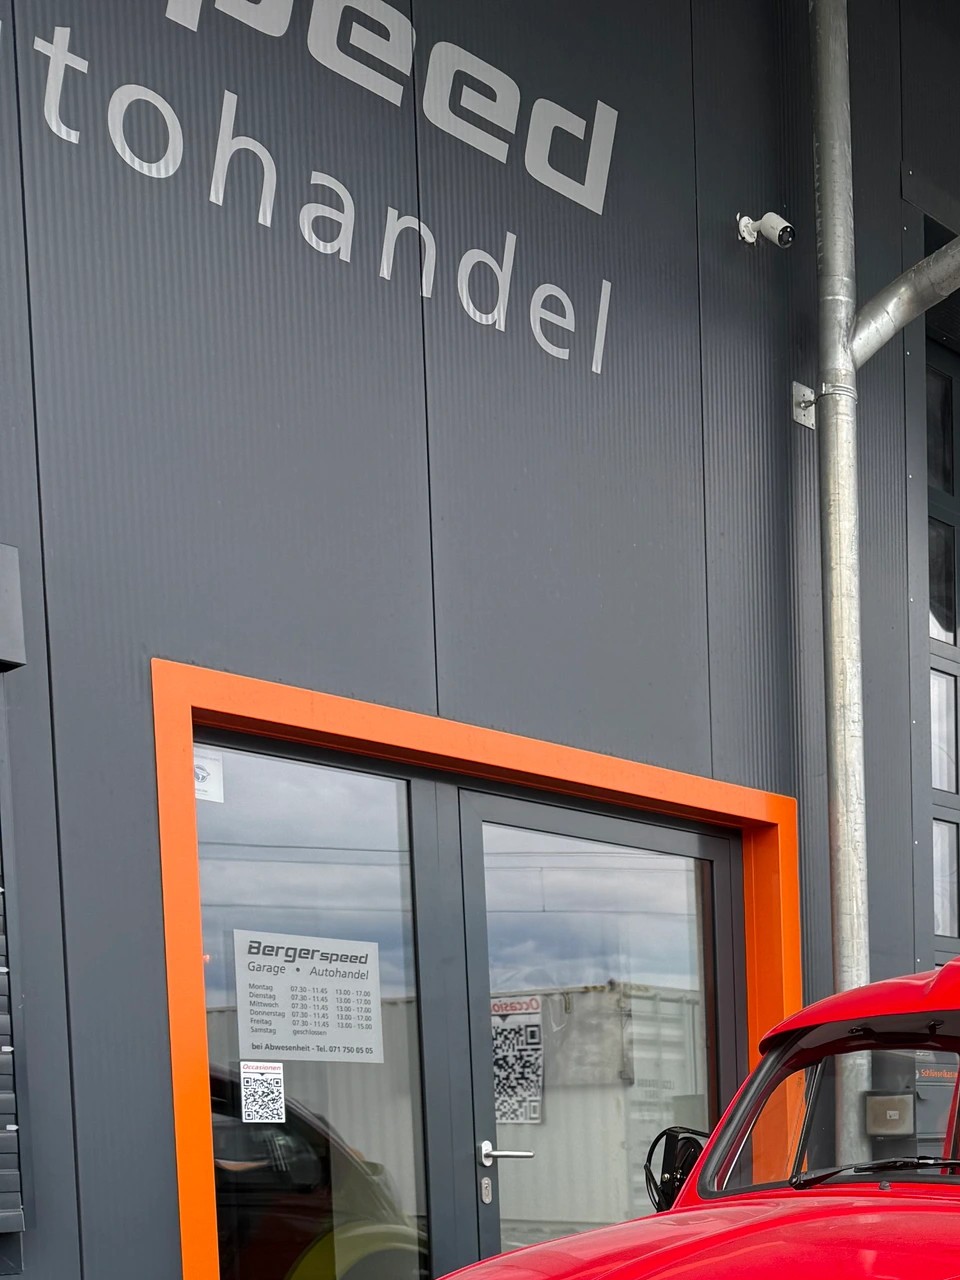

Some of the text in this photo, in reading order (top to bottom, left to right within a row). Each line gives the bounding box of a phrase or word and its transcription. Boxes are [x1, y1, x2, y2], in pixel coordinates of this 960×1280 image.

[0, 20, 612, 374] tohandel
[247, 940, 369, 964] Bergerspeed
[247, 961, 369, 980] Garage Autohandel
[249, 983, 273, 992] Montag
[249, 991, 276, 1001] Dienstag
[250, 1000, 279, 1008] Mittwoch
[250, 1009, 286, 1018] Donnerstag
[250, 1017, 272, 1026] Freitag
[251, 1026, 276, 1035] Samstag
[264, 1043, 310, 1052] Abwesenheit
[242, 1063, 281, 1071] Occasionen
